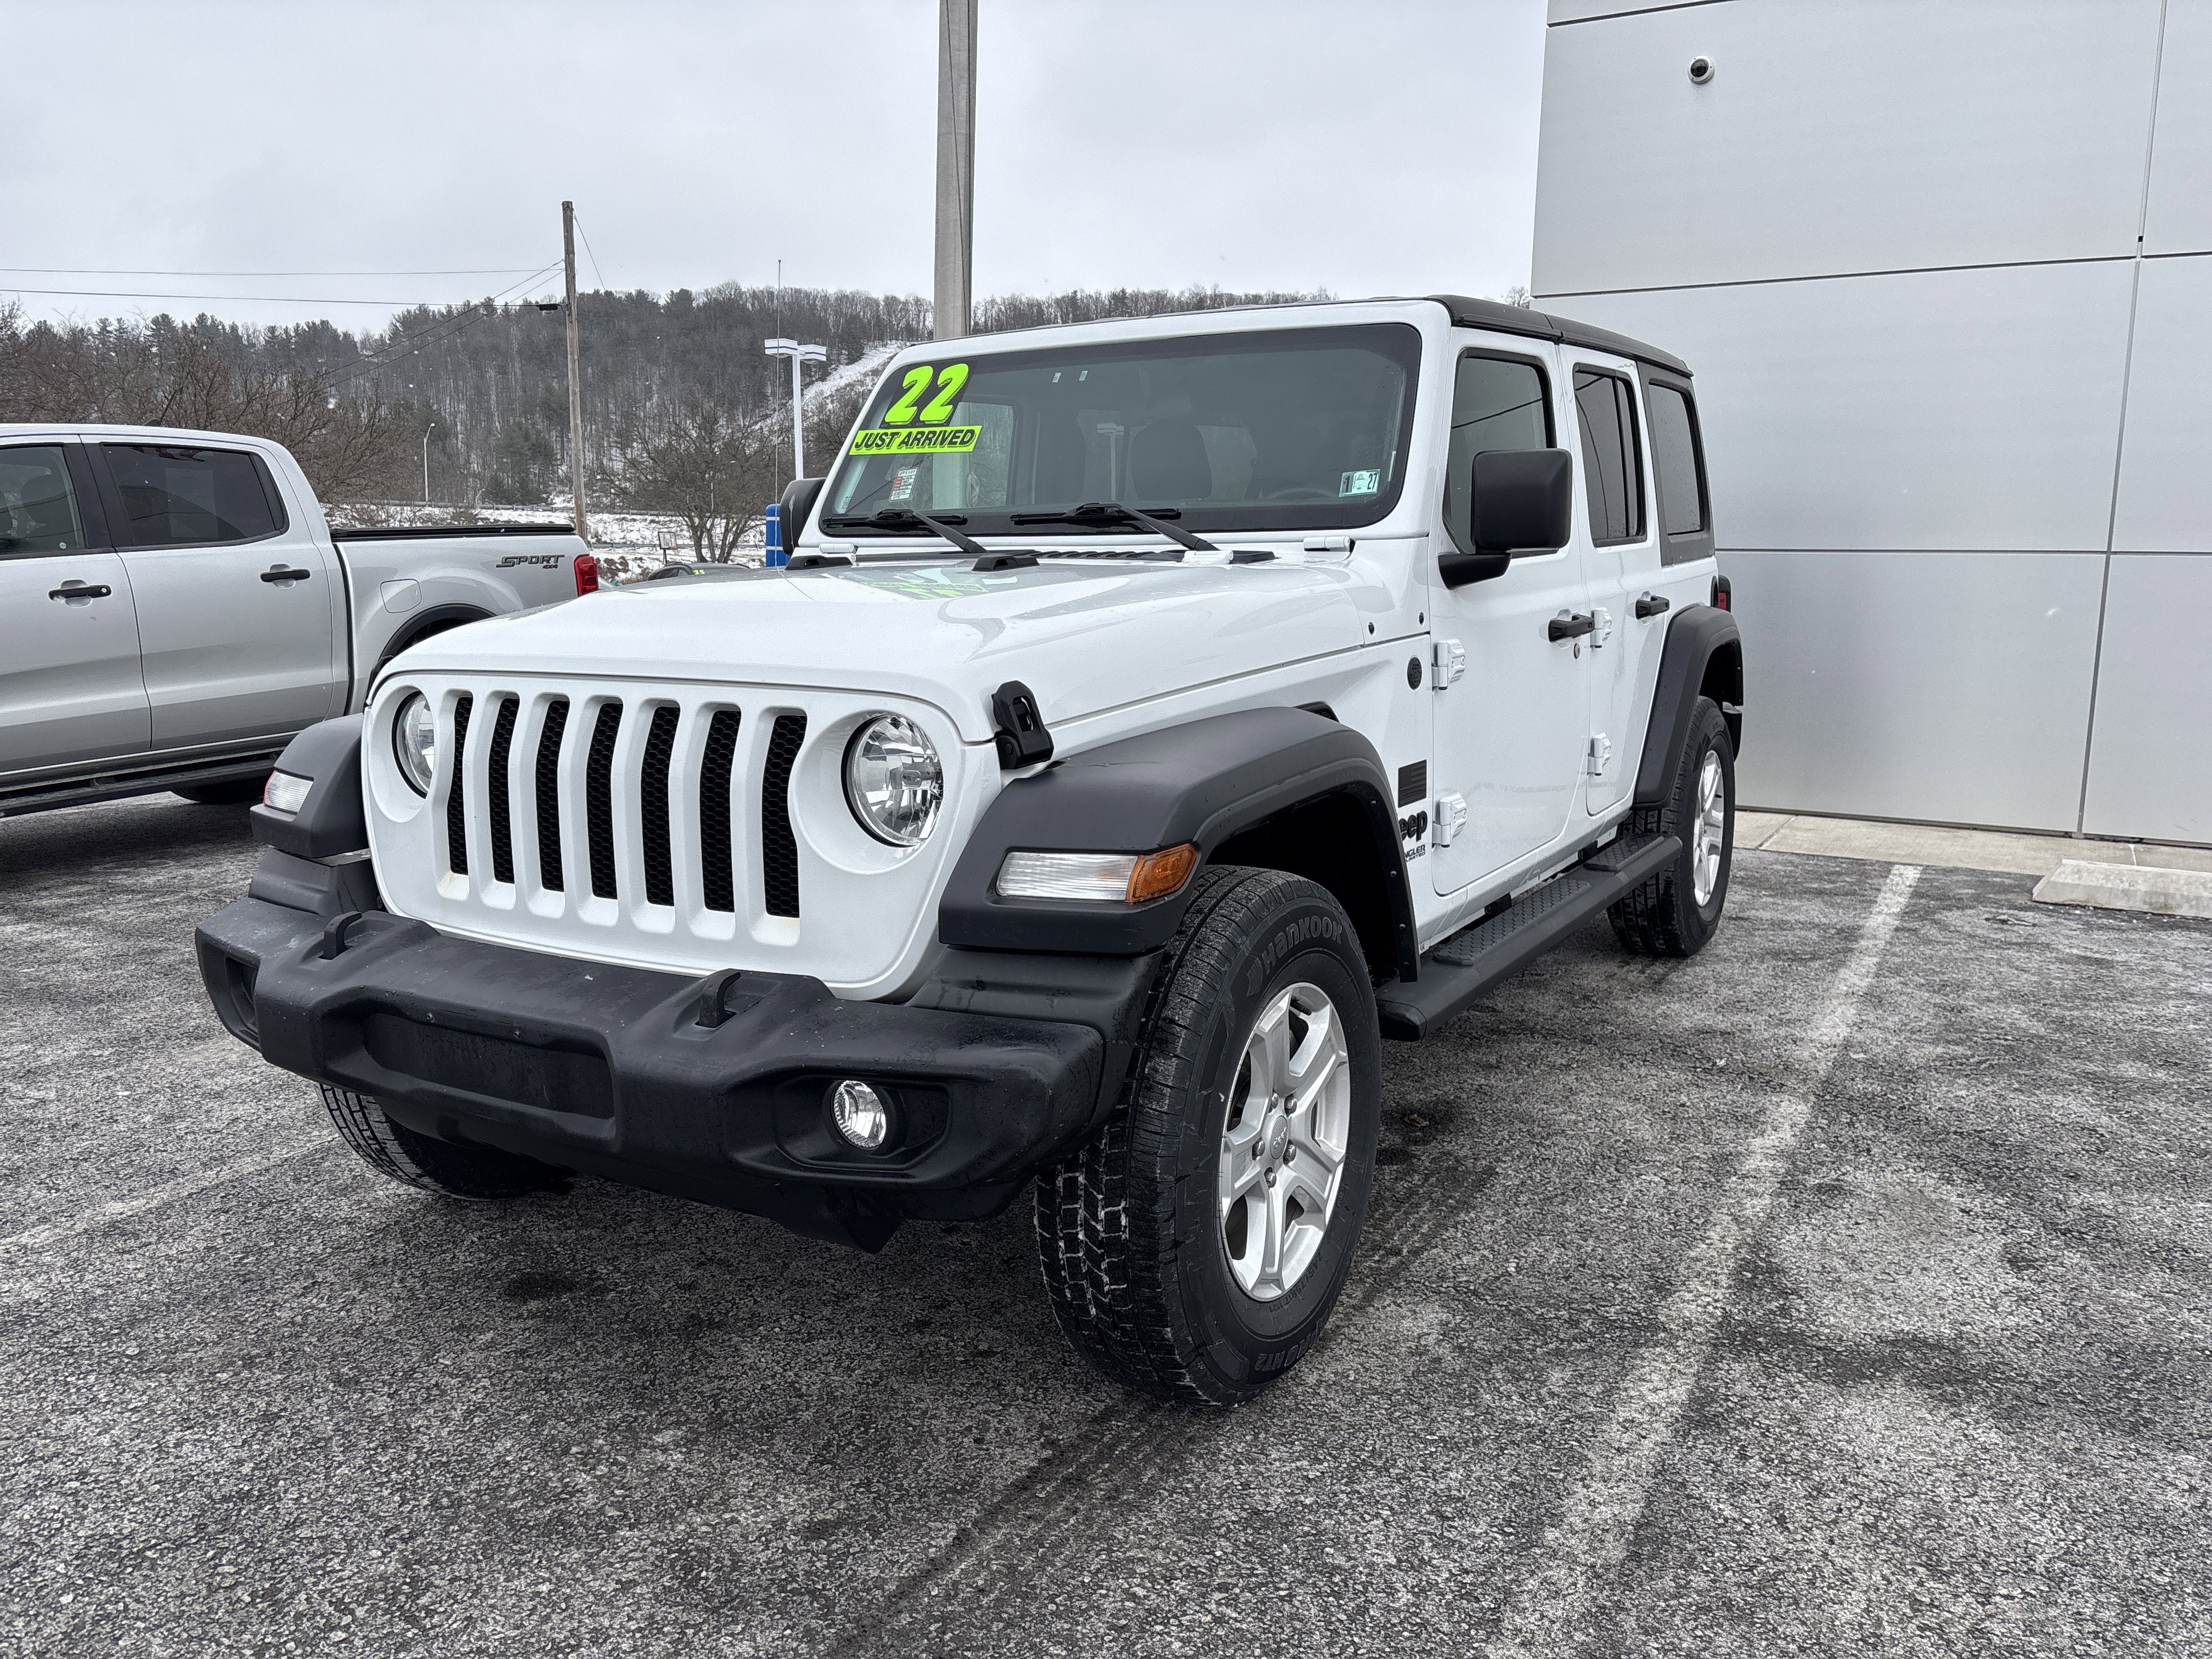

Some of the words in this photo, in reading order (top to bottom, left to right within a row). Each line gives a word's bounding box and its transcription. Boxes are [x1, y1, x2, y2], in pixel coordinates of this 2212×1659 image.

[884, 363, 969, 425] 22
[854, 431, 901, 451] JUST
[896, 428, 976, 449] ARRIVED
[1367, 472, 1378, 490] 27
[496, 554, 565, 568] SPORT
[1399, 810, 1428, 842] eep
[1404, 844, 1425, 858] NGLER
